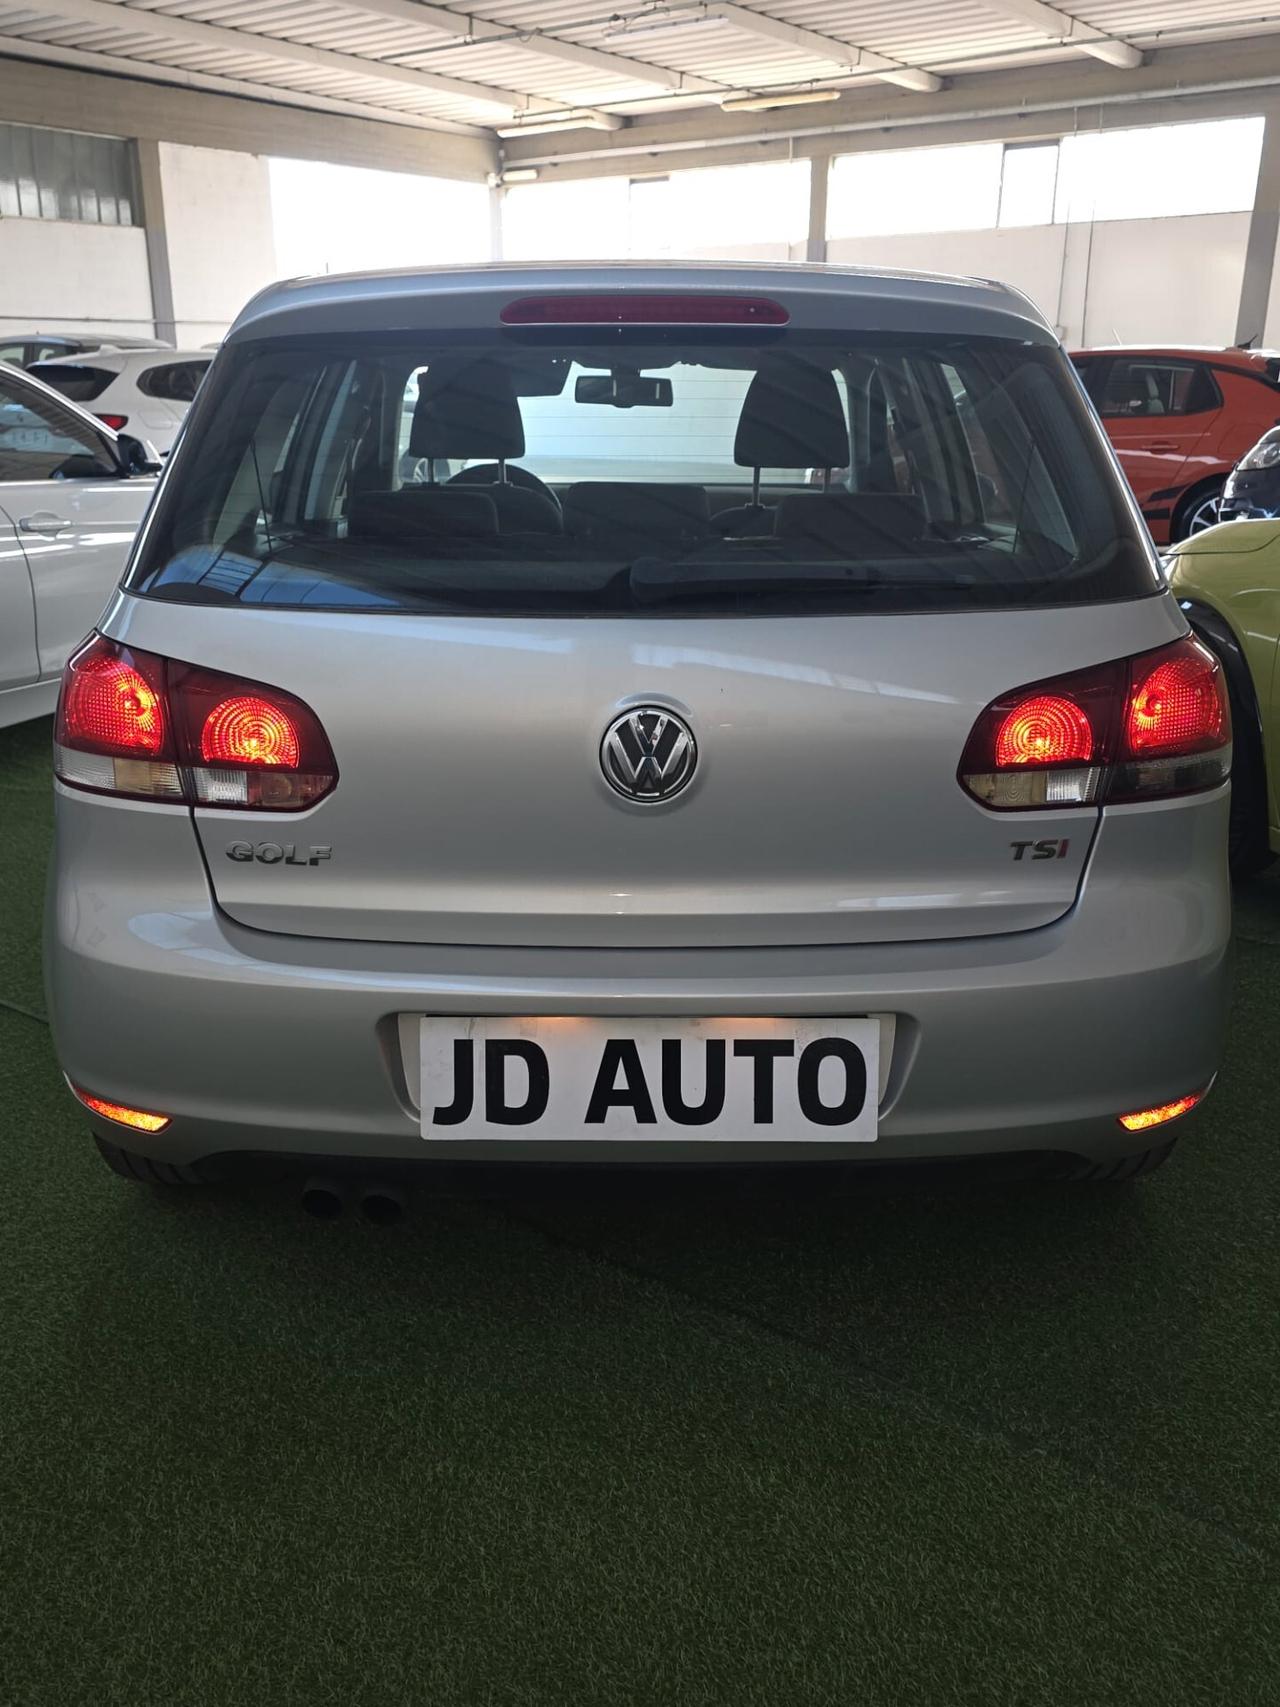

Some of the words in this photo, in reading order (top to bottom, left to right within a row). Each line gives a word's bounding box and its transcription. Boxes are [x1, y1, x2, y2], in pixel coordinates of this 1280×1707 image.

[225, 840, 332, 866] GOLF
[1010, 838, 1070, 861] TSI
[432, 1038, 550, 1126] JD
[584, 1037, 867, 1127] AUTO
